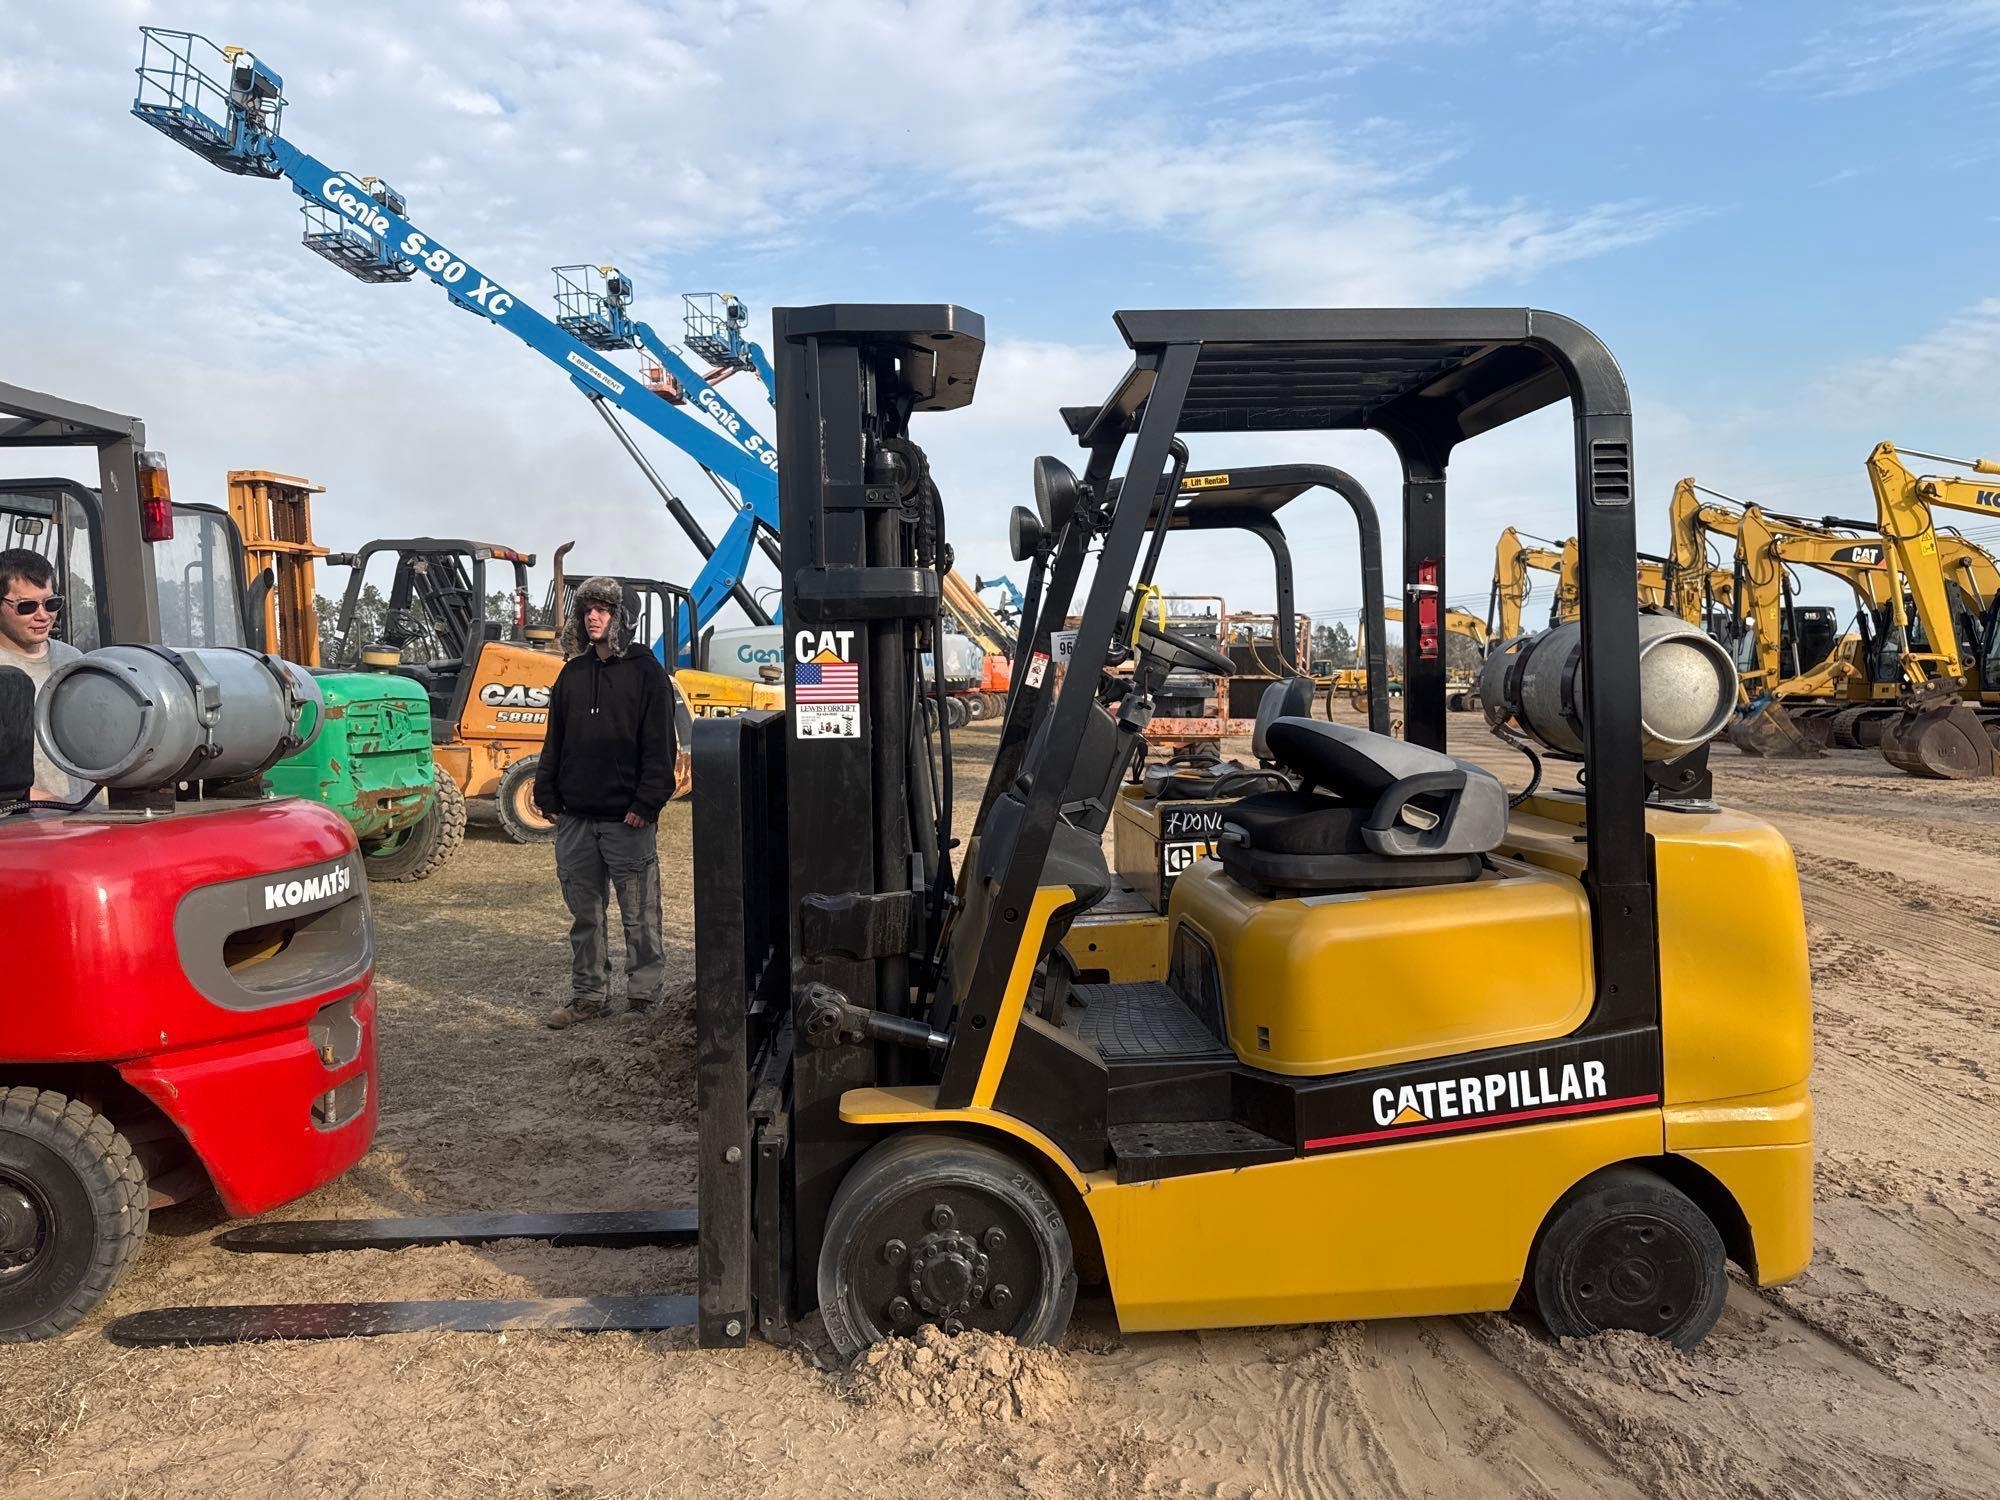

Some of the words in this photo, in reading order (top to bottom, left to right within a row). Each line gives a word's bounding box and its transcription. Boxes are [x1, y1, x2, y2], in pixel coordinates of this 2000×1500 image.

[322, 177, 390, 236] Genie
[400, 232, 467, 283] S-80
[466, 277, 514, 316] XC
[698, 388, 741, 435] Genie
[1190, 478, 1202, 488] Lift
[1204, 476, 1228, 486] Rentals
[1851, 547, 1879, 564] CAT
[737, 643, 784, 664] Geni
[795, 629, 855, 664] CAT
[480, 683, 550, 708] CAS
[496, 710, 547, 724] 588H
[800, 704, 823, 713] LEWIS
[823, 704, 857, 713] FORKLIFT
[264, 864, 351, 910] KOMATSU
[1371, 1059, 1608, 1127] CATERPILLAR
